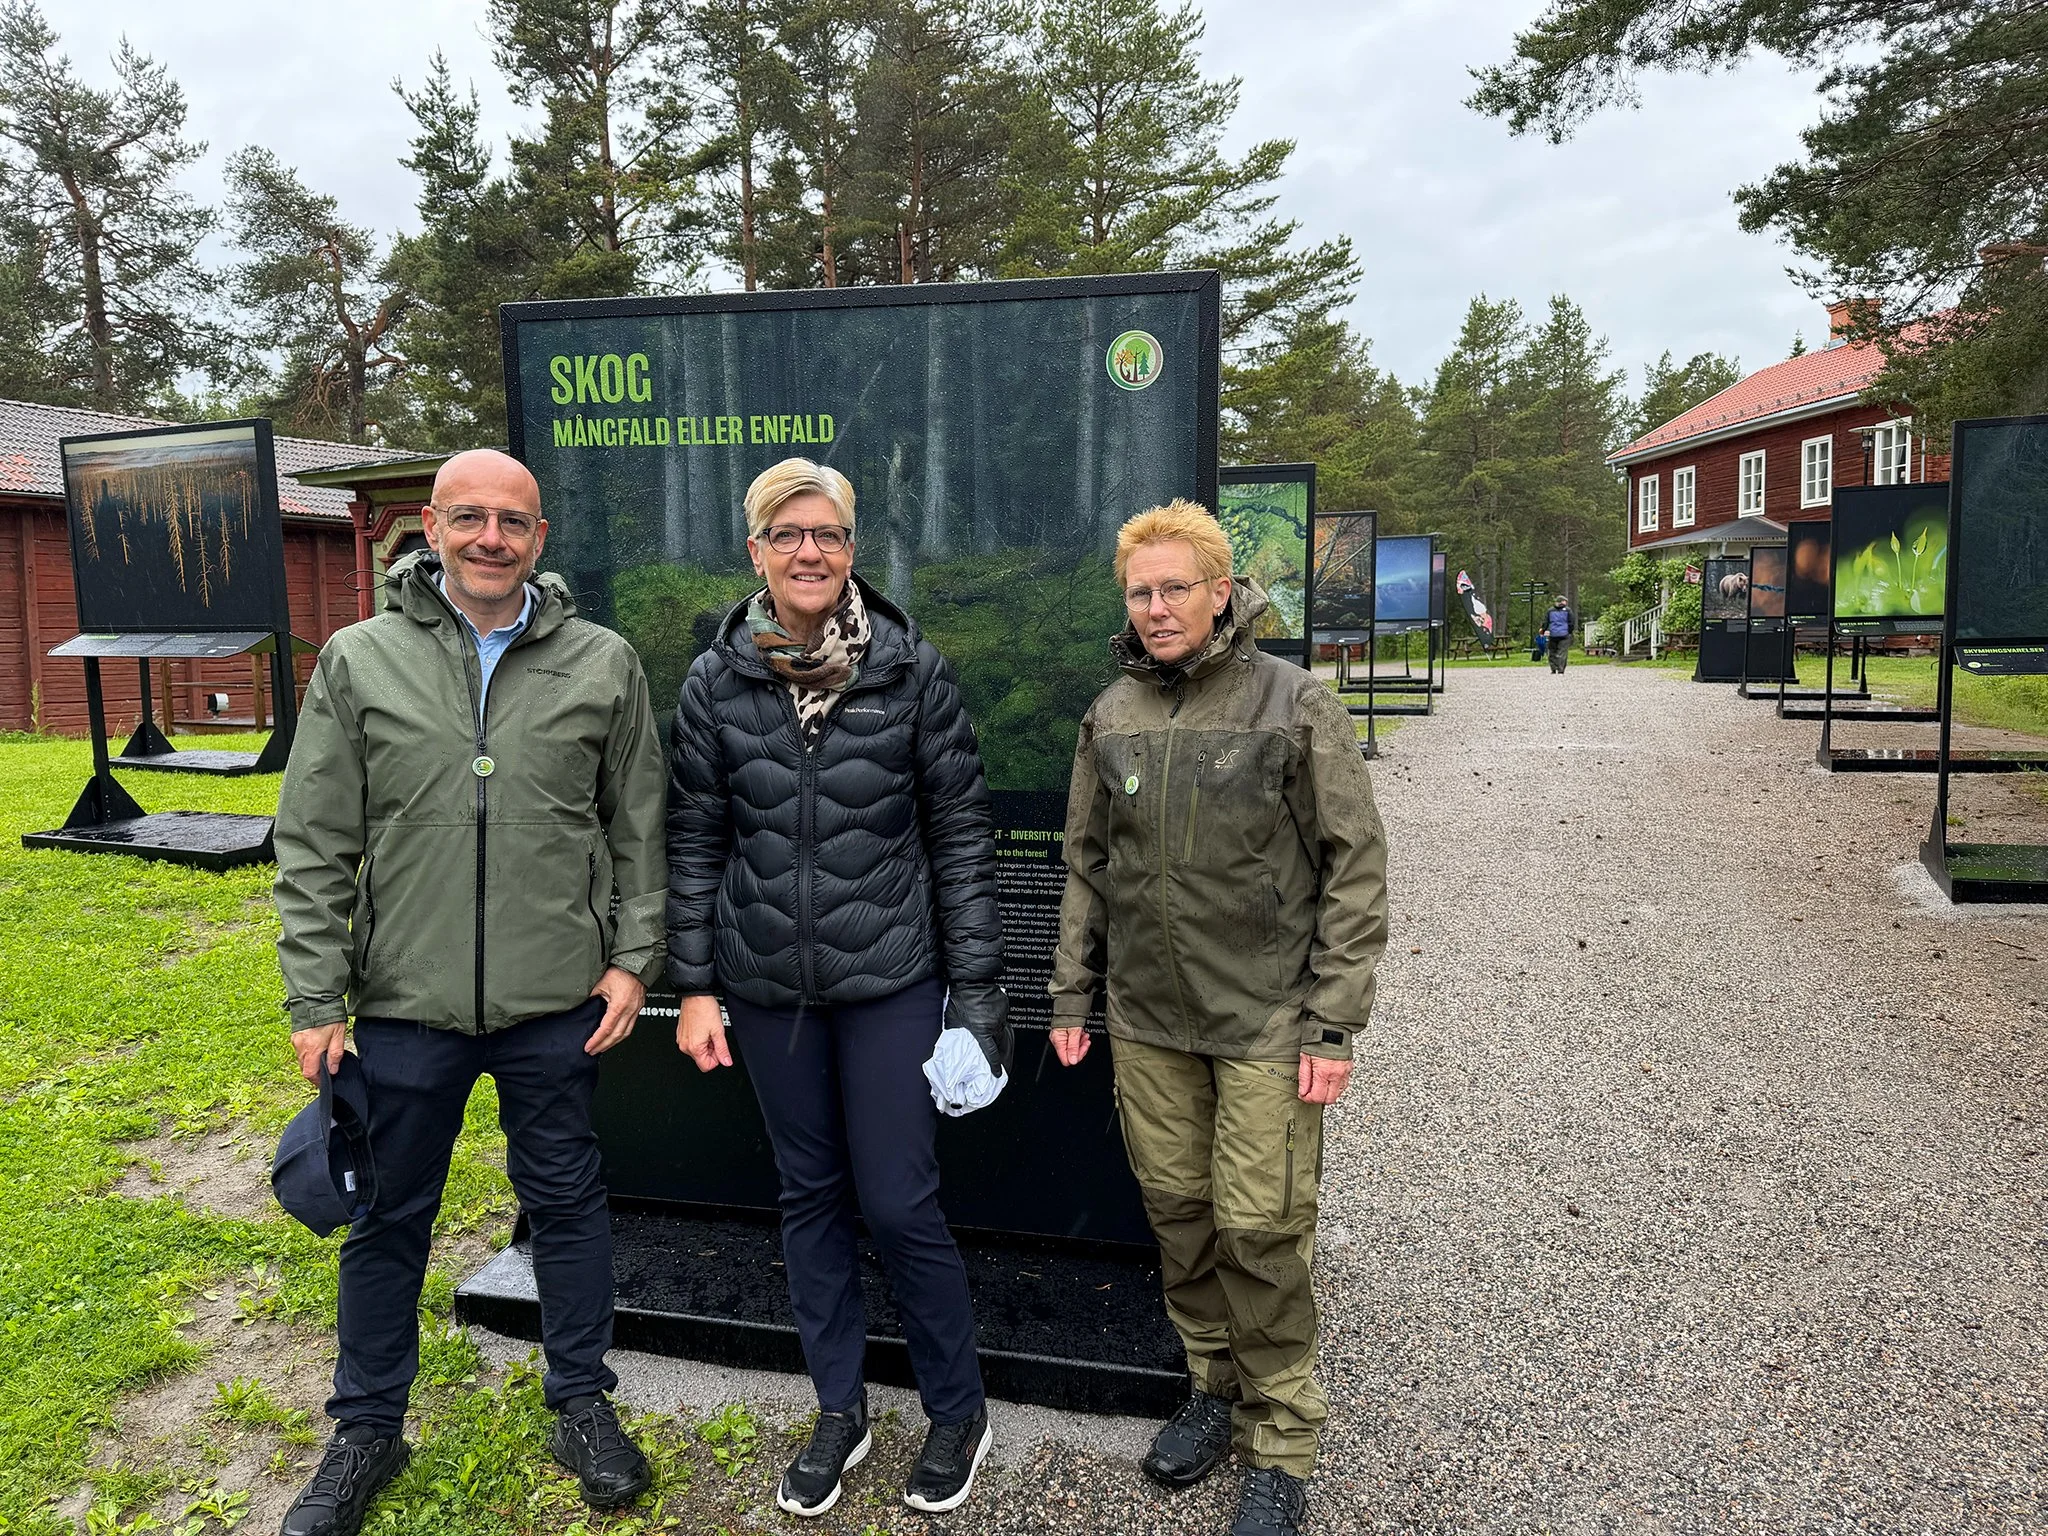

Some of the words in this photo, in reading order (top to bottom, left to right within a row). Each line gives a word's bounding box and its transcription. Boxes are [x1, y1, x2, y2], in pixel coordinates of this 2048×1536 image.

[550, 352, 651, 404] SKOG
[553, 413, 670, 447] MÅNGFALD
[677, 415, 743, 445] ELLER
[750, 413, 834, 443] ENFALD
[1011, 830, 1051, 841] DIVERSITY
[1053, 831, 1064, 841] OR
[1025, 848, 1048, 858] forest!
